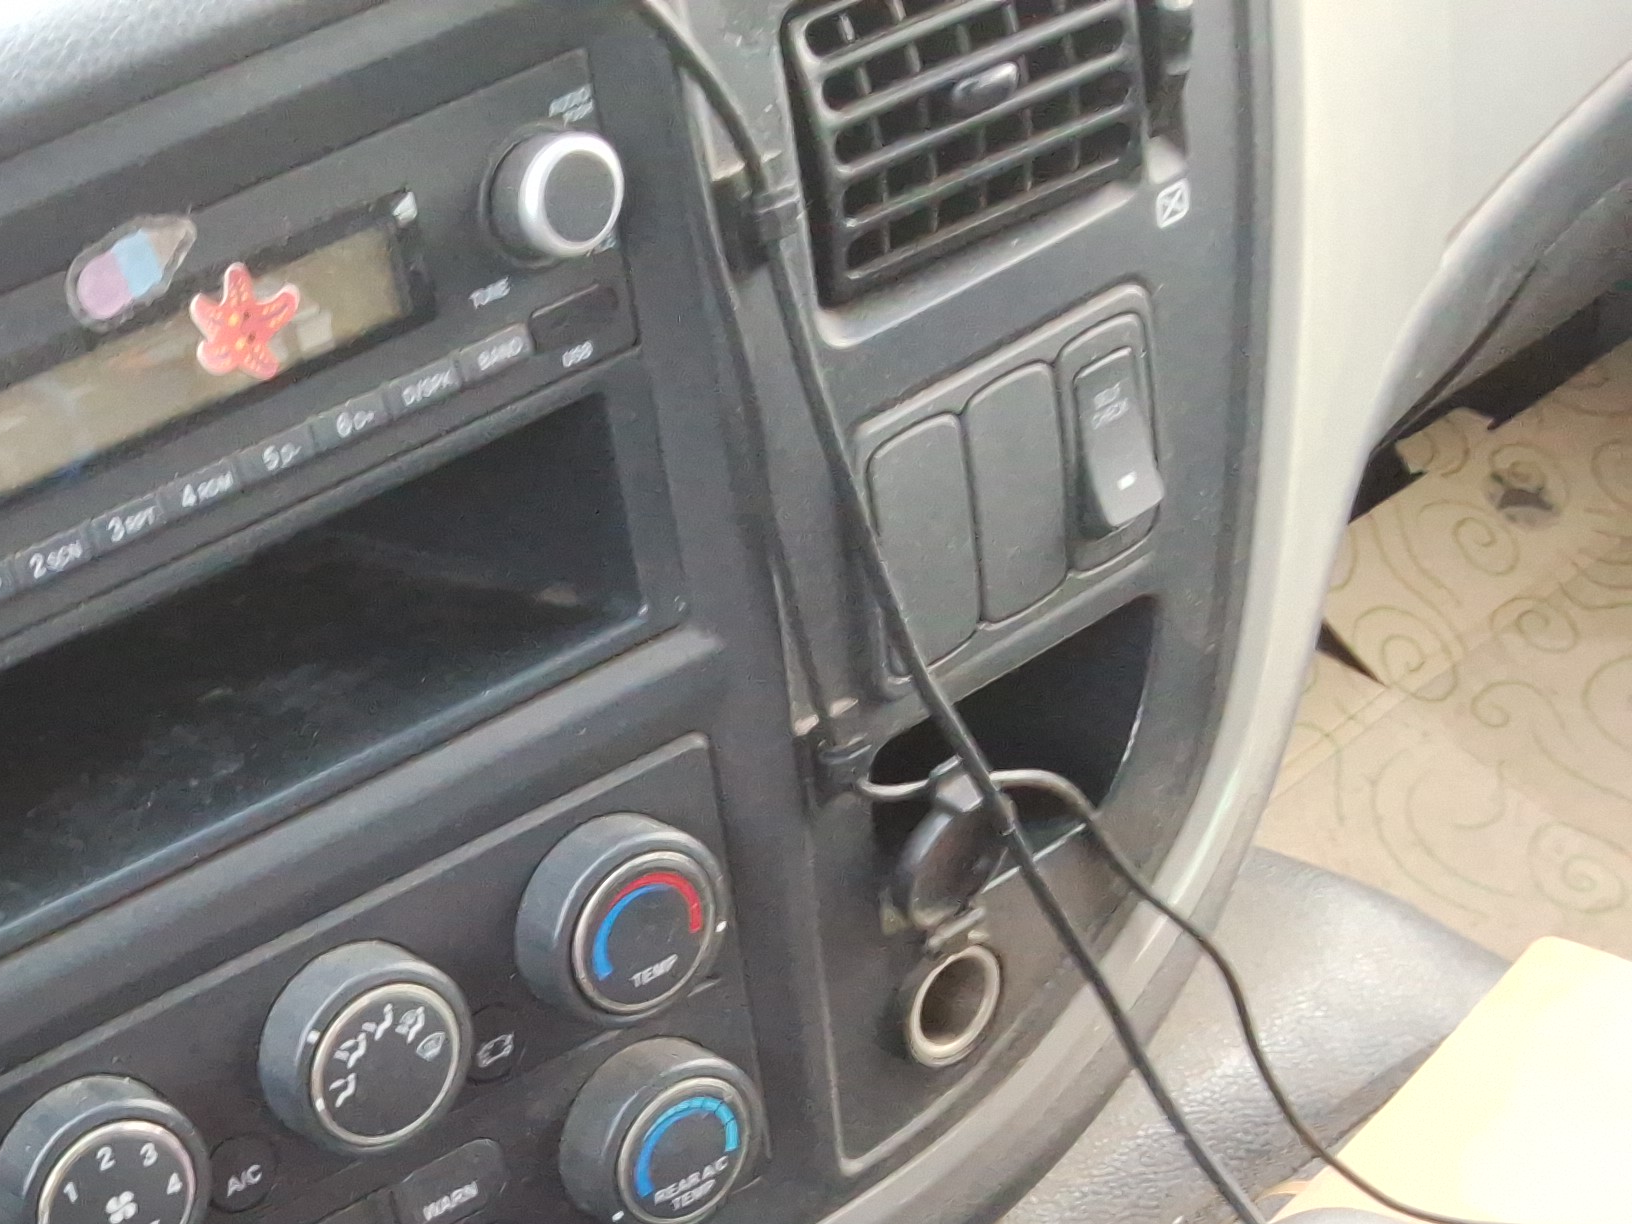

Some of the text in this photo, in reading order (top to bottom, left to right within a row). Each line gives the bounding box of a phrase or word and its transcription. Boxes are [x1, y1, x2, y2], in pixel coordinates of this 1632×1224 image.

[107, 516, 124, 542] 3
[29, 553, 47, 579] 2
[631, 954, 678, 987] TEMP
[96, 1147, 116, 1171] 2
[140, 1142, 158, 1167] 3
[64, 1182, 79, 1203] 1
[167, 1172, 183, 1195] 4
[227, 1164, 262, 1197] A/C
[654, 1169, 701, 1205] REAR
[671, 1179, 716, 1210] TEMP
